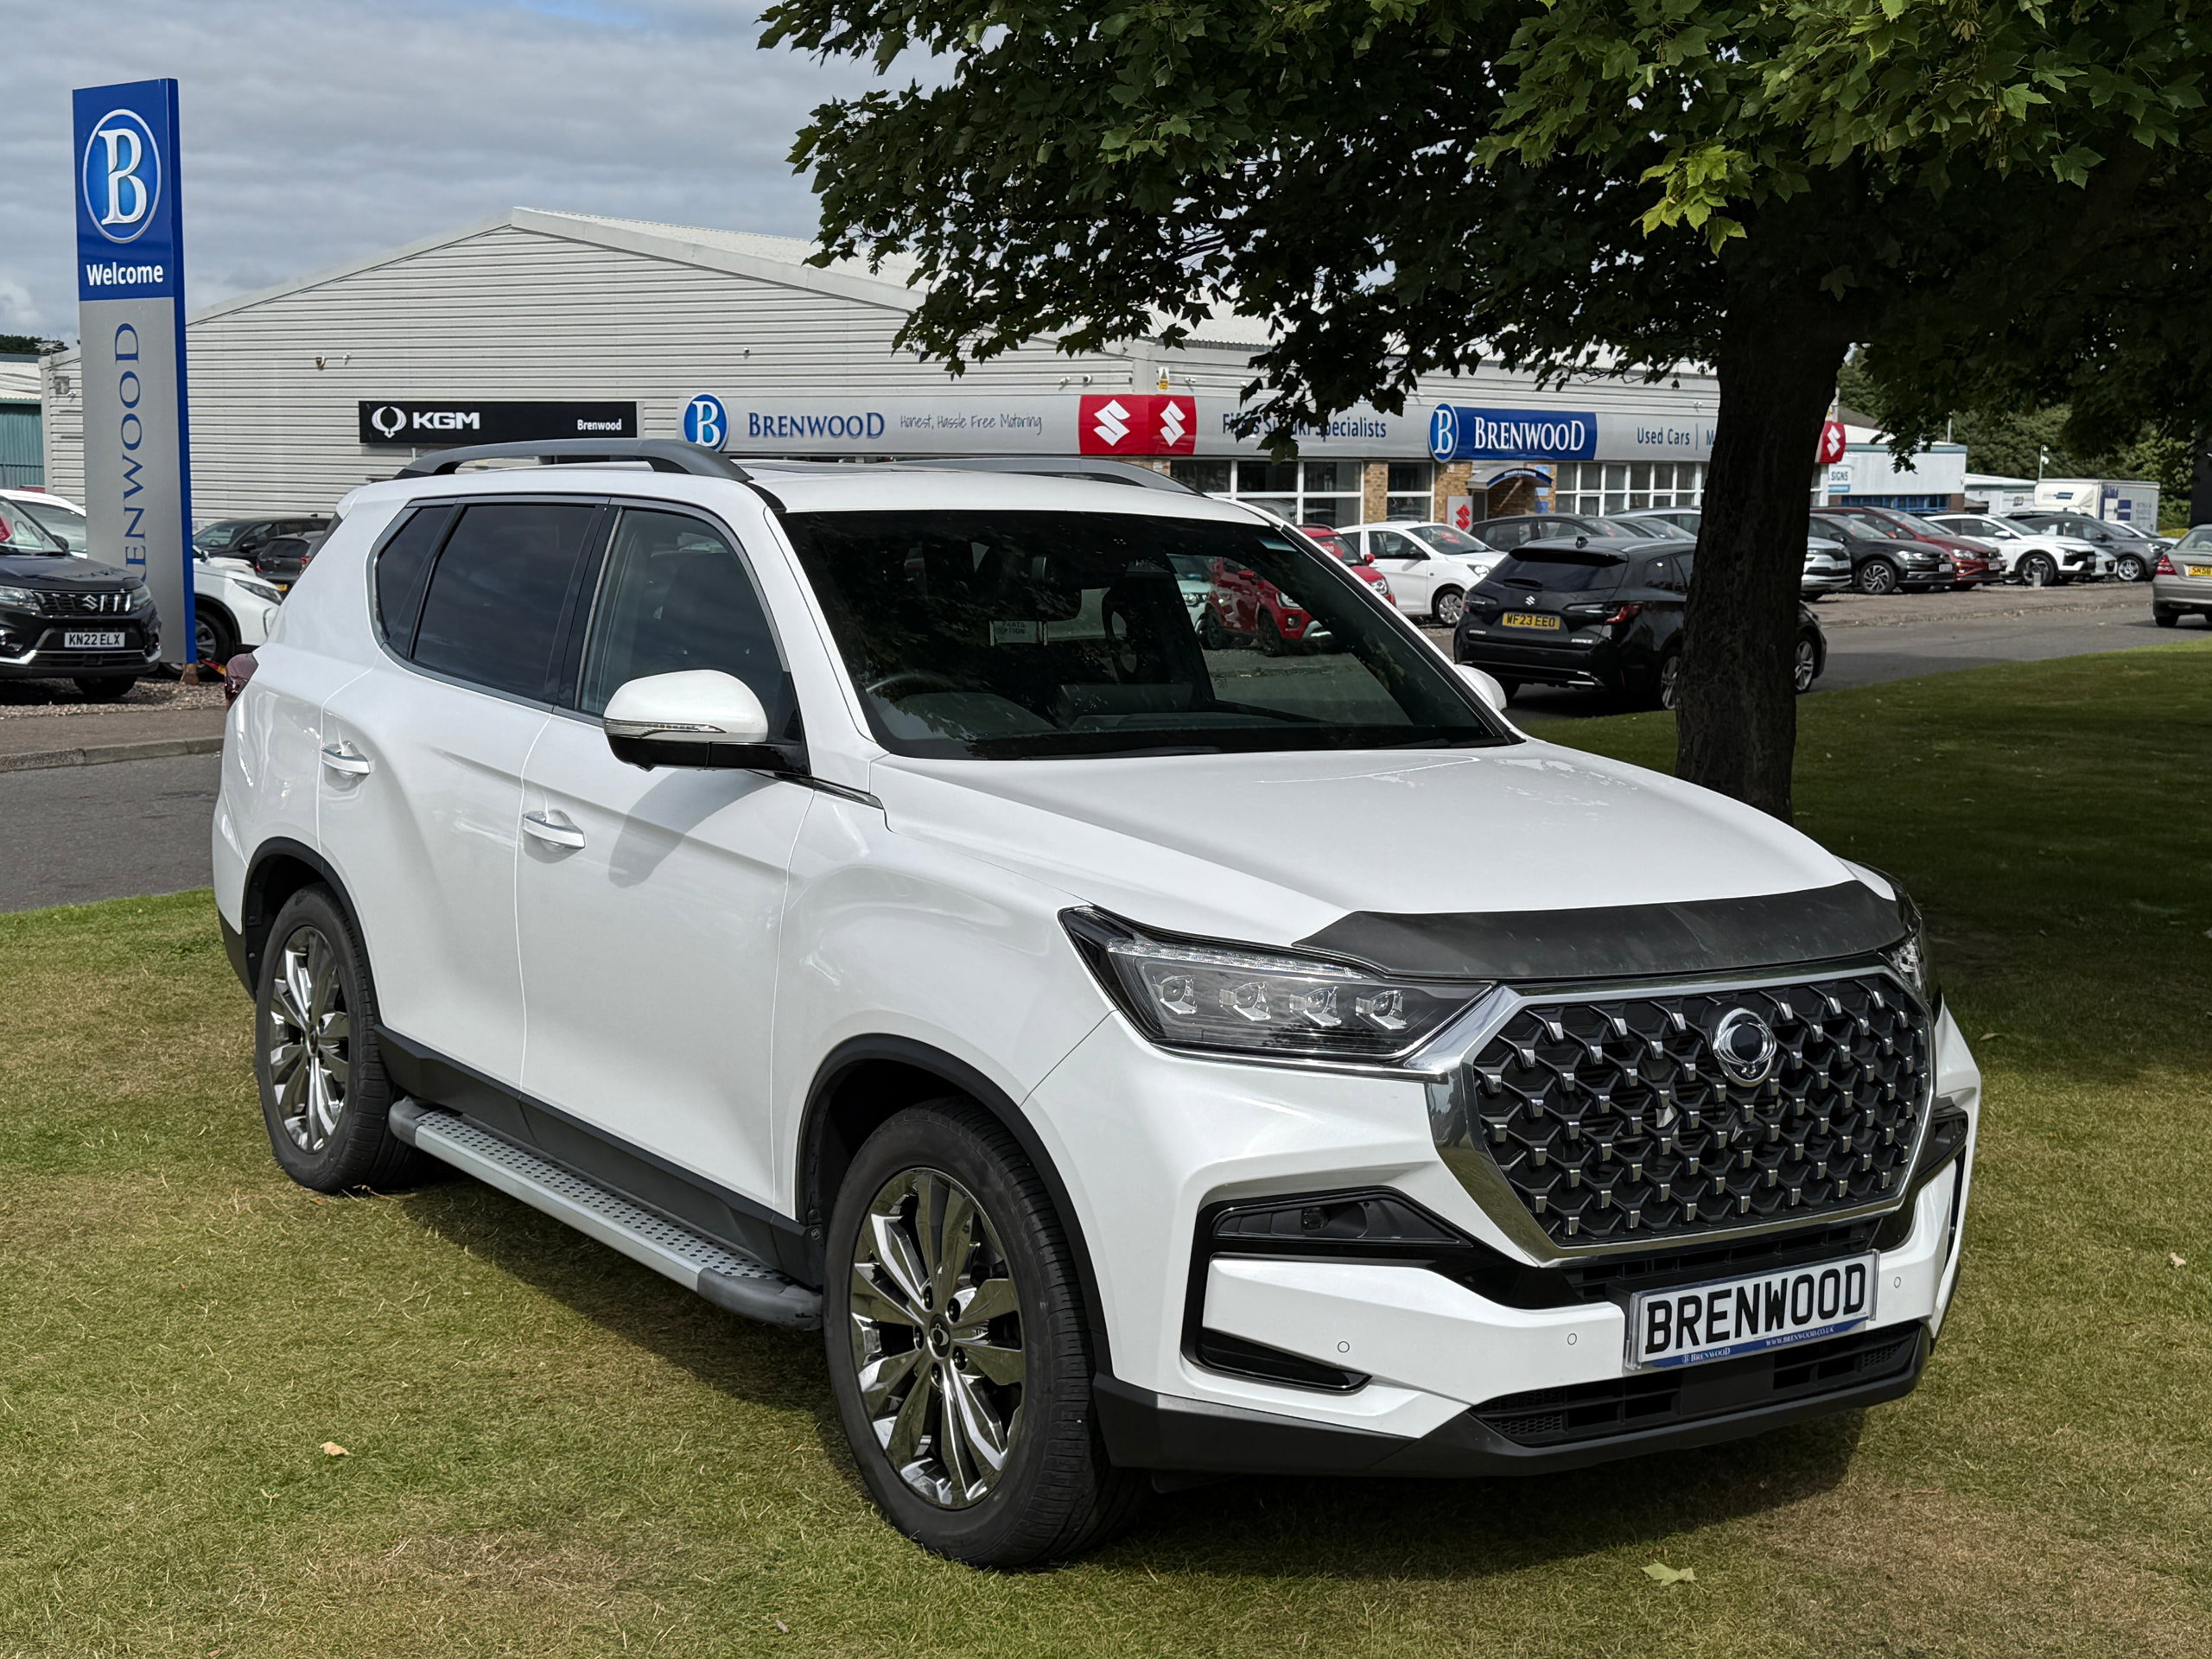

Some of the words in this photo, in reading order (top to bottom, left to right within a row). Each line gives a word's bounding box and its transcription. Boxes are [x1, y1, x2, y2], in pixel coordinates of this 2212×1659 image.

[98, 128, 147, 226] B
[86, 262, 163, 286] Welcome
[412, 411, 480, 429] KGM
[577, 418, 622, 431] Brenwood
[691, 400, 721, 447] B
[747, 411, 885, 438] BRENWOOD
[900, 413, 934, 429] Honest,
[938, 411, 967, 429] Hassle
[970, 414, 995, 429] Free
[1001, 412, 1042, 435] Motoring
[1434, 409, 1453, 454] B
[1474, 416, 1586, 451] BRENWOOD
[1637, 427, 1663, 444] Used
[1667, 428, 1690, 445] Cars
[114, 322, 146, 582] ENWOOD
[1506, 613, 1533, 626] WF23
[1535, 616, 1555, 627] EEO
[69, 634, 98, 645] KN22
[100, 634, 120, 645] ELX
[1645, 1262, 1866, 1355] BRENWOOD
[1690, 1347, 1731, 1362] BRENWOOD
